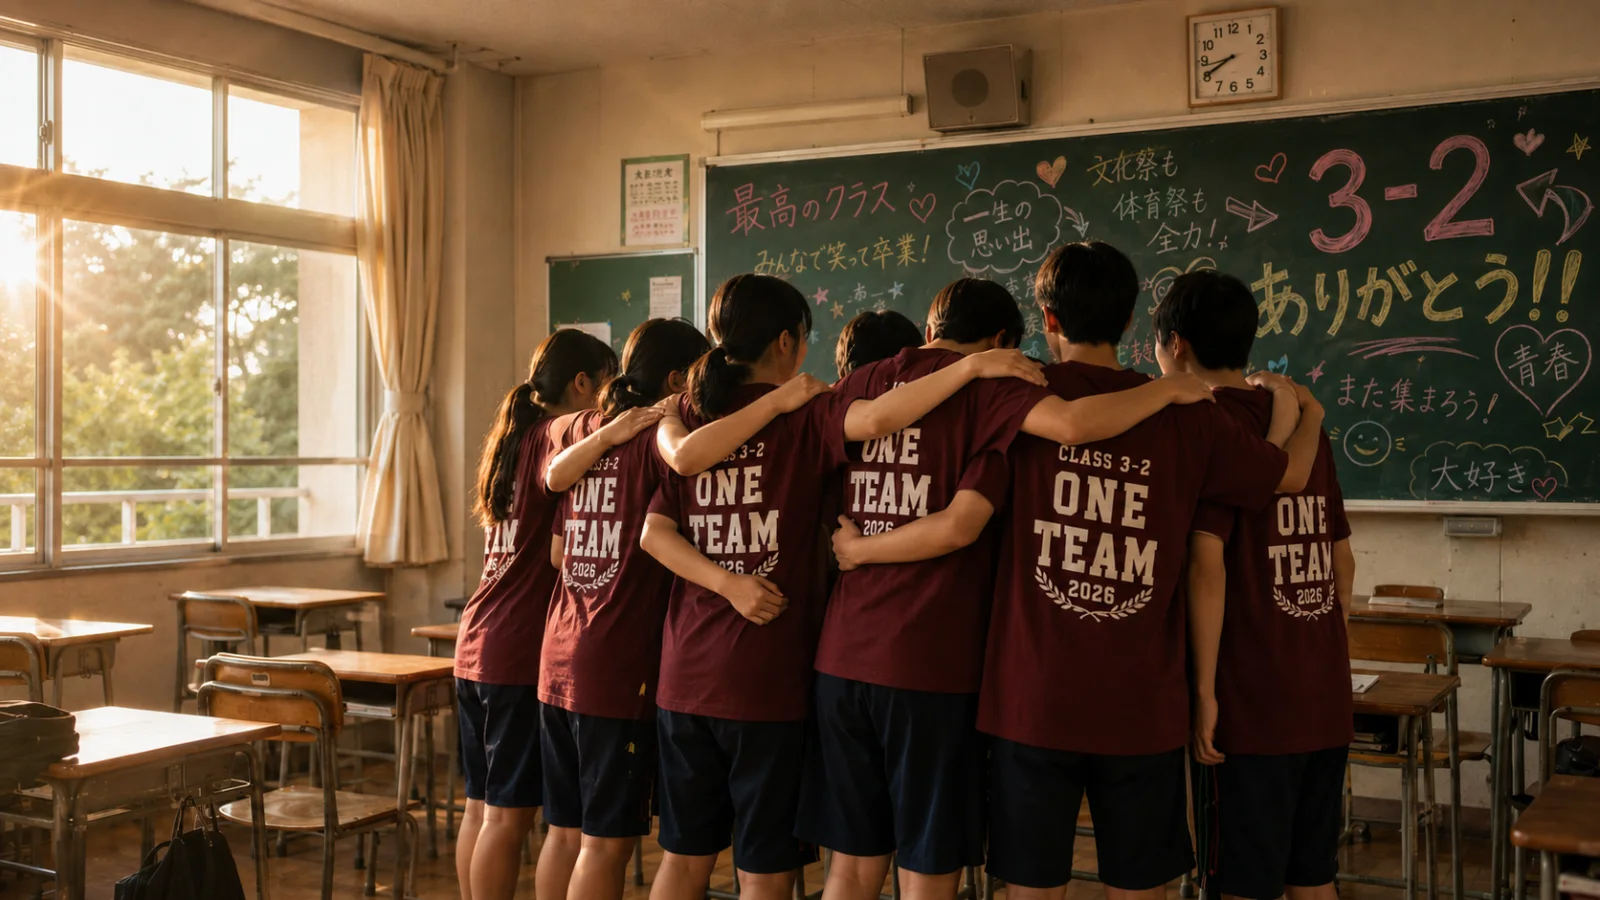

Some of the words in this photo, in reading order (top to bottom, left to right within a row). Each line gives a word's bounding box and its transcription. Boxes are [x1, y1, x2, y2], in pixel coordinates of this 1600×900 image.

[1213, 27, 1223, 38] 11
[1227, 23, 1239, 35] 12
[1247, 24, 1252, 35] 1
[1256, 33, 1264, 45] 2
[1202, 40, 1214, 51] 10
[1259, 49, 1267, 60] 3
[1201, 55, 1209, 67] 9
[1256, 66, 1264, 76] 4
[1203, 71, 1211, 82] 8
[1215, 80, 1223, 92] 7
[1229, 81, 1238, 92] 6
[1246, 78, 1254, 89] 5
[1086, 149, 1178, 187] 文化祭も
[1112, 187, 1207, 221] 体育祭も
[1308, 134, 1495, 253] 3-2
[725, 181, 896, 237] 最高のクラス
[963, 200, 1032, 225] 一生の
[971, 226, 1033, 258] 思い出
[1508, 342, 1579, 388] 青春
[739, 442, 765, 459] 3-2
[861, 428, 921, 466] ONE
[1058, 444, 1112, 470] CLASS
[1120, 456, 1151, 476] 3-2
[603, 456, 619, 470] 3-2
[1431, 457, 1526, 494] 大好き
[572, 477, 617, 513] ONE
[696, 465, 763, 506] ONE
[850, 471, 931, 517] TEAM
[1053, 470, 1149, 530] ONE
[1277, 496, 1327, 536] ONE
[563, 519, 622, 560] TEAM
[689, 510, 779, 554] TEAM
[1034, 519, 1158, 586] TEAM
[1268, 541, 1334, 586] TEAM
[572, 562, 596, 578] 2026
[1068, 579, 1115, 605] 2026
[1297, 587, 1323, 605] 2026
